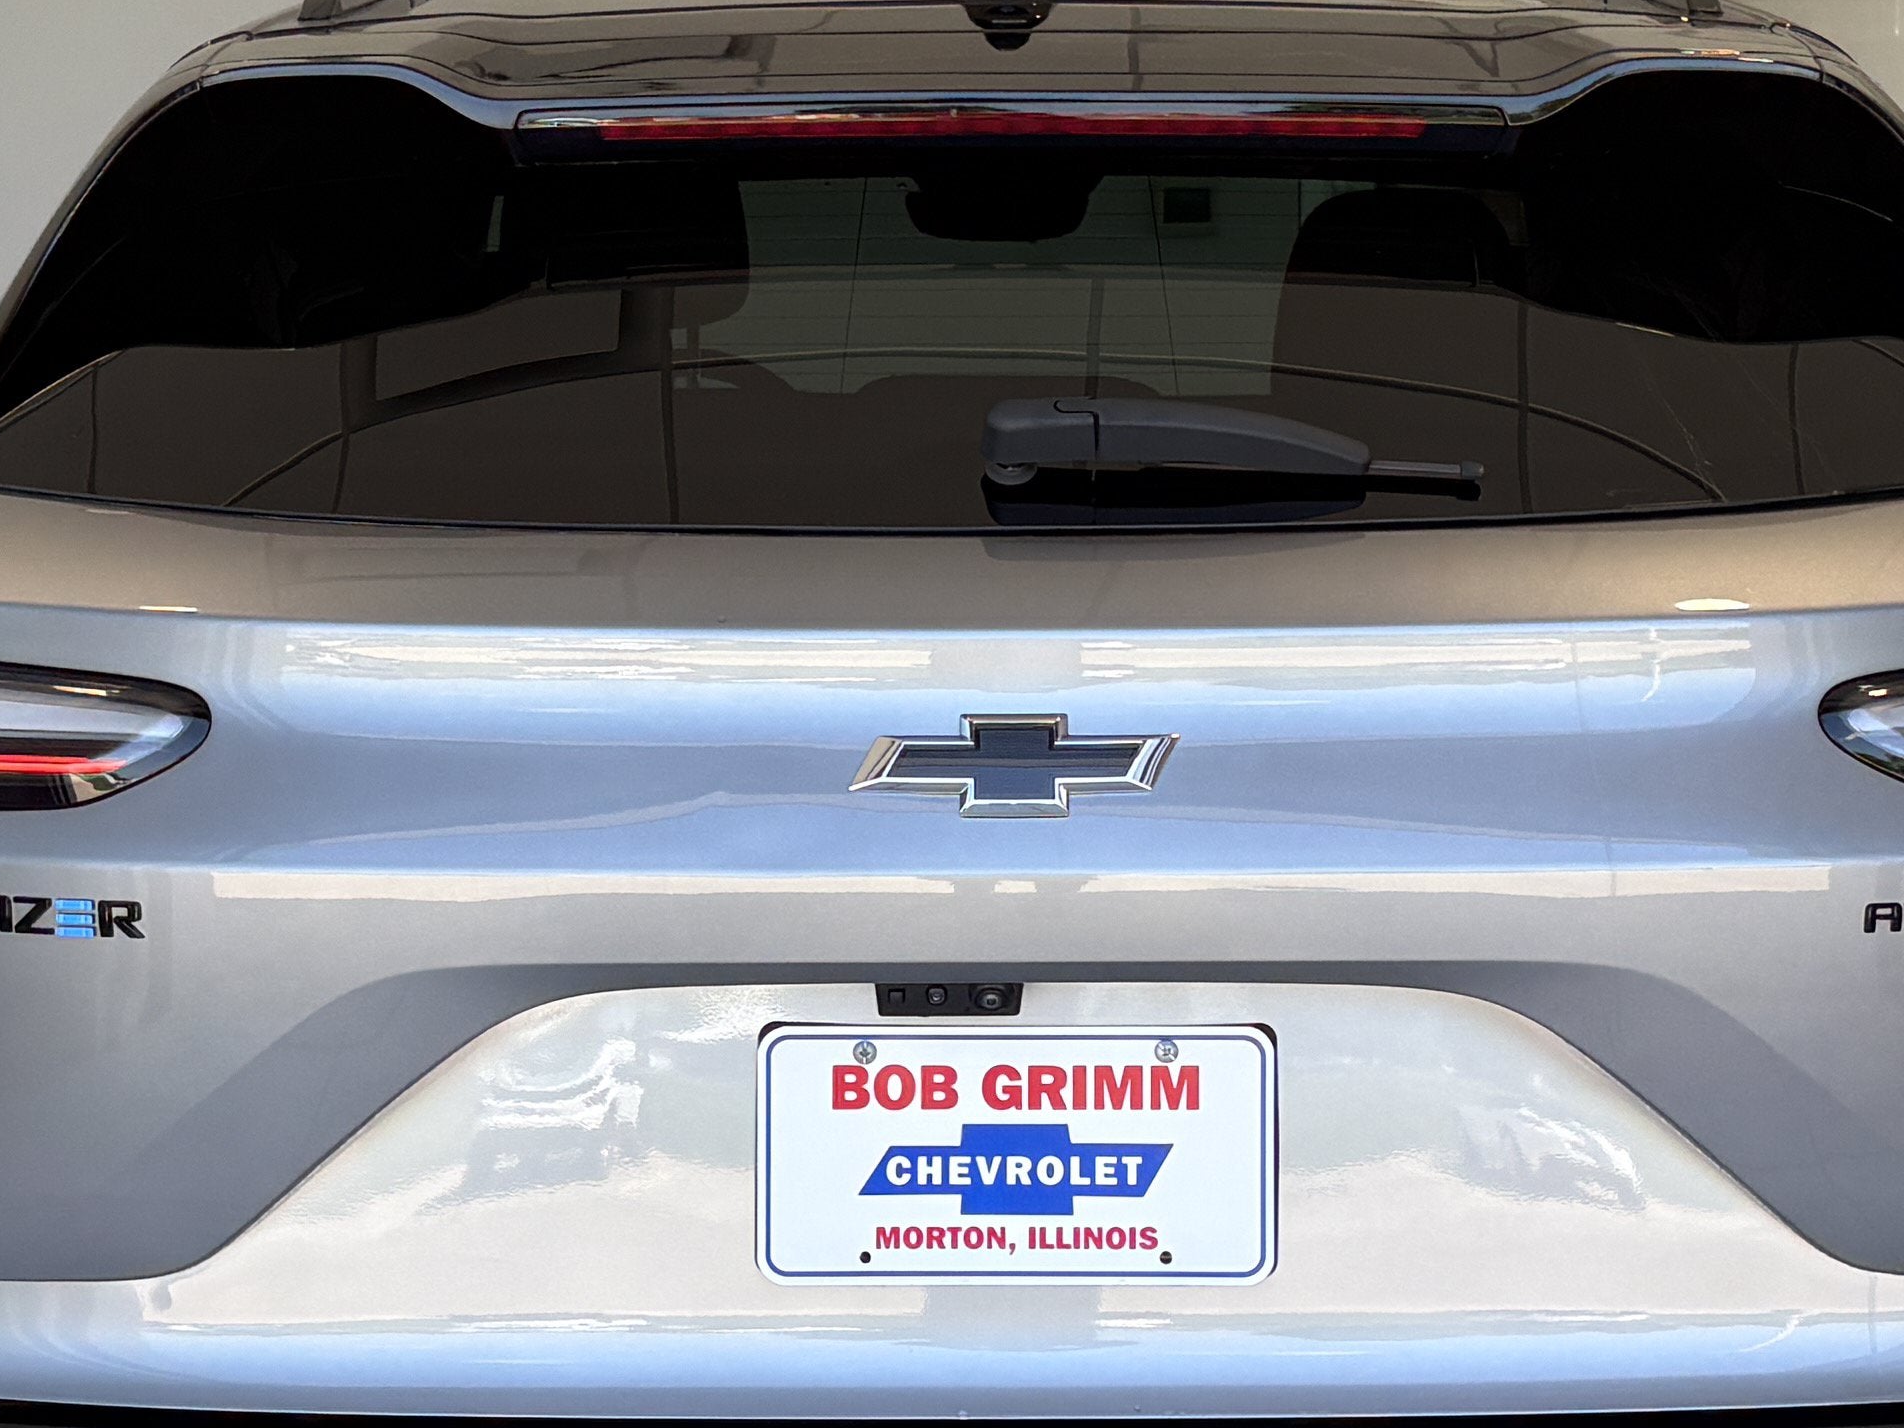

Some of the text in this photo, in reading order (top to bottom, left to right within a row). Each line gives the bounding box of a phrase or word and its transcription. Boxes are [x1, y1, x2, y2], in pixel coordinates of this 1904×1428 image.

[831, 1063, 1201, 1112] BOB GRIMM
[884, 1154, 1146, 1186] CHEVROLET
[874, 1225, 1160, 1254] MORTON, ILLINOIS
